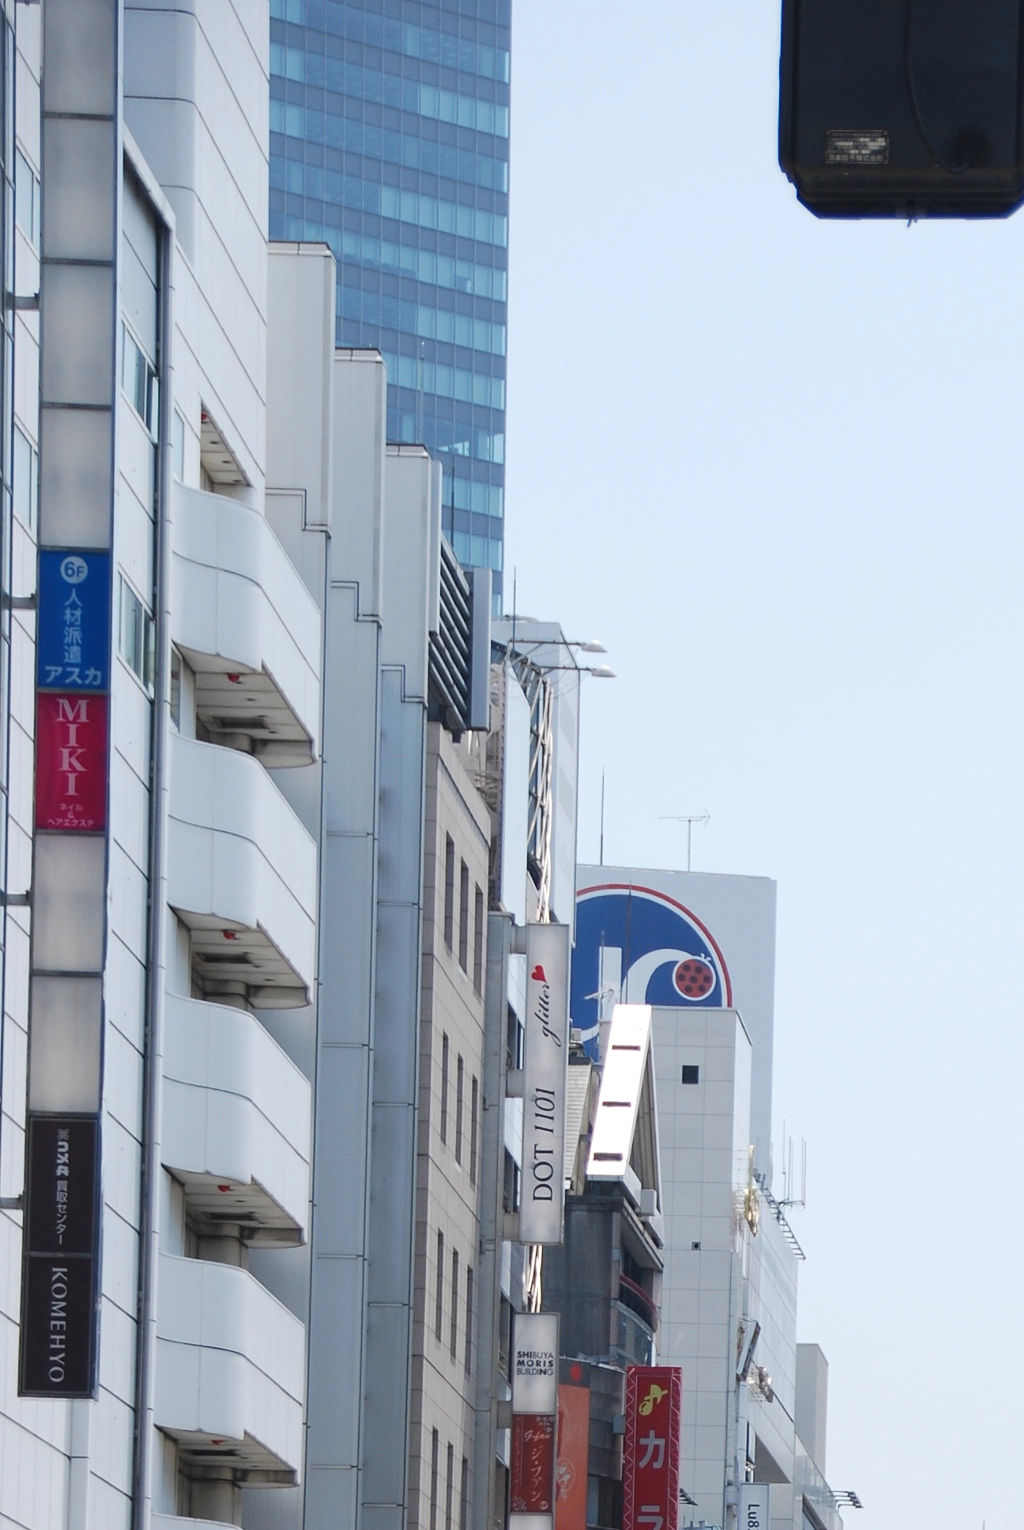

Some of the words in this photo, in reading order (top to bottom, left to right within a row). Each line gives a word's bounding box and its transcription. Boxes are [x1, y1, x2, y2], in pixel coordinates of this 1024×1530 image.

[64, 562, 85, 578] 6F
[63, 588, 83, 663] 人材派遣
[45, 665, 102, 686] アスカ
[57, 698, 90, 796] MIKI
[534, 1086, 556, 1134] 1101
[532, 1146, 554, 1202] DOT
[56, 1179, 69, 1246] 買取センター
[48, 1266, 69, 1383] KOMEHYO
[516, 1359, 554, 1368] MORIS
[516, 1368, 554, 1376] BUILDING
[517, 1351, 554, 1359] SHIBUYA
